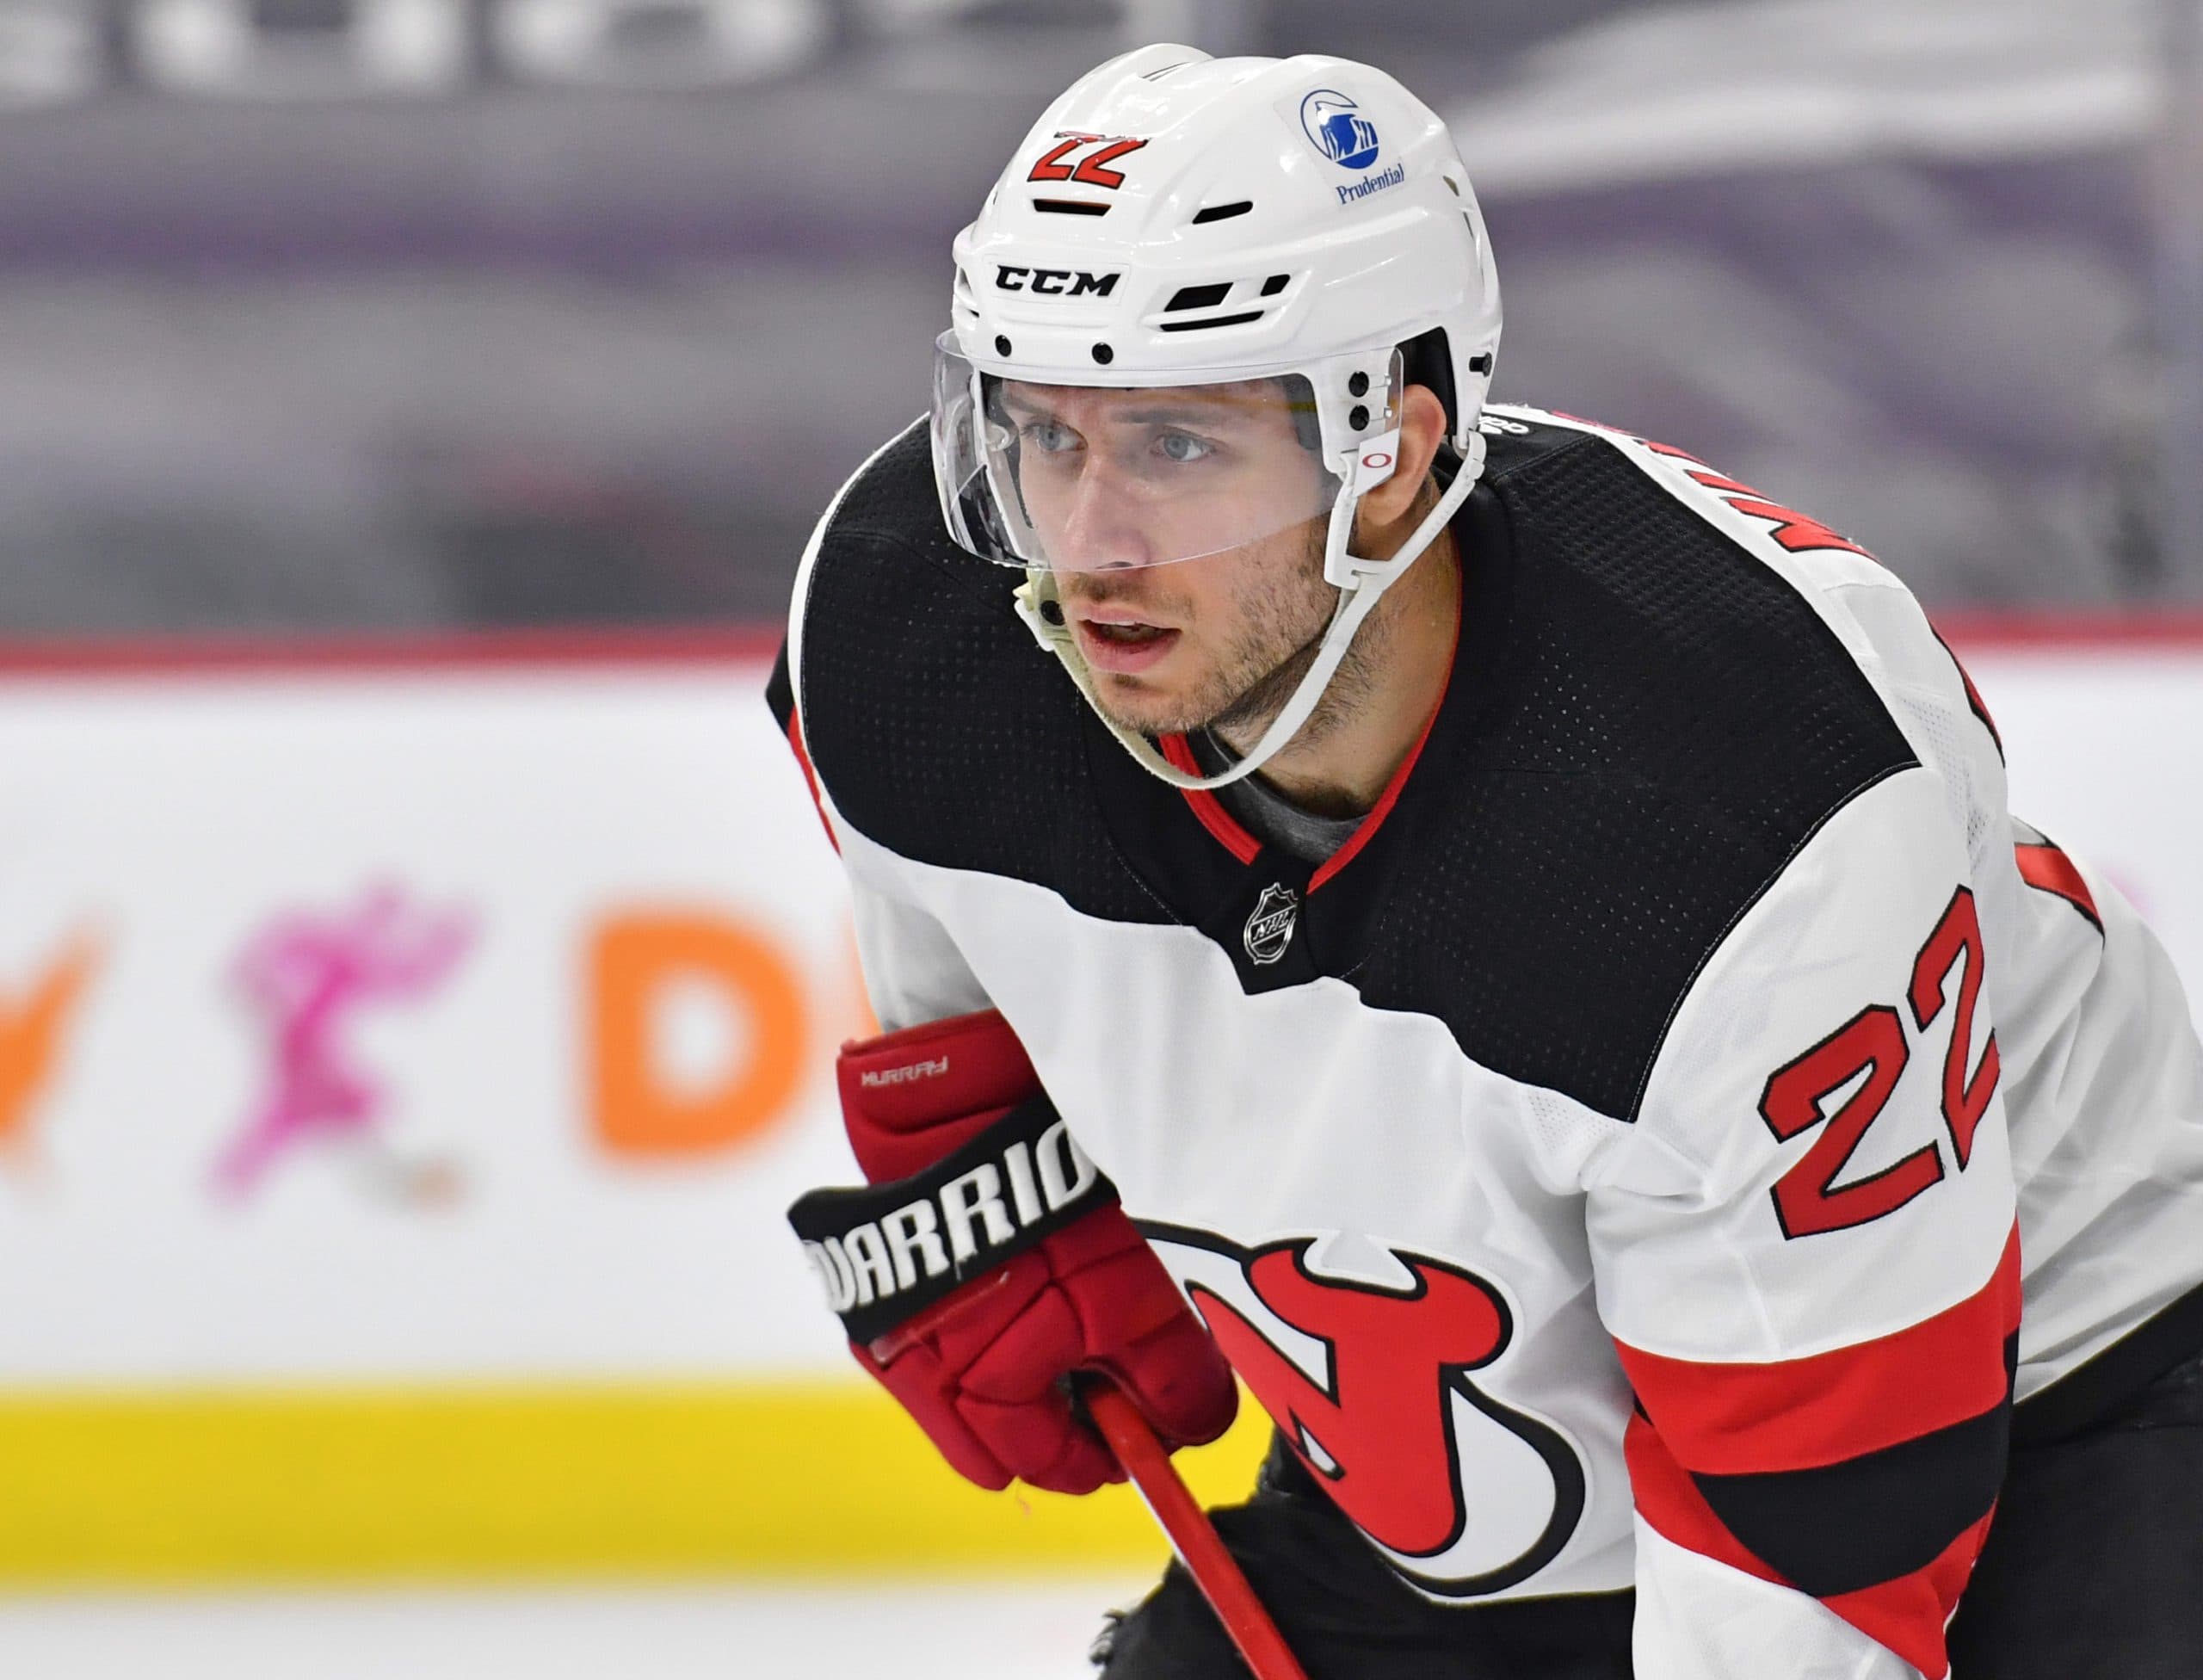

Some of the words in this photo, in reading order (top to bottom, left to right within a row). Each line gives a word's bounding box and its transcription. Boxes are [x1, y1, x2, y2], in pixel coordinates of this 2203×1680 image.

[1027, 131, 1151, 189] 22
[1336, 163, 1404, 205] Prudential
[996, 264, 1121, 297] CCM
[1253, 911, 1289, 941] NHL
[861, 1055, 948, 1087] MURRAY
[1757, 884, 2001, 1241] 22
